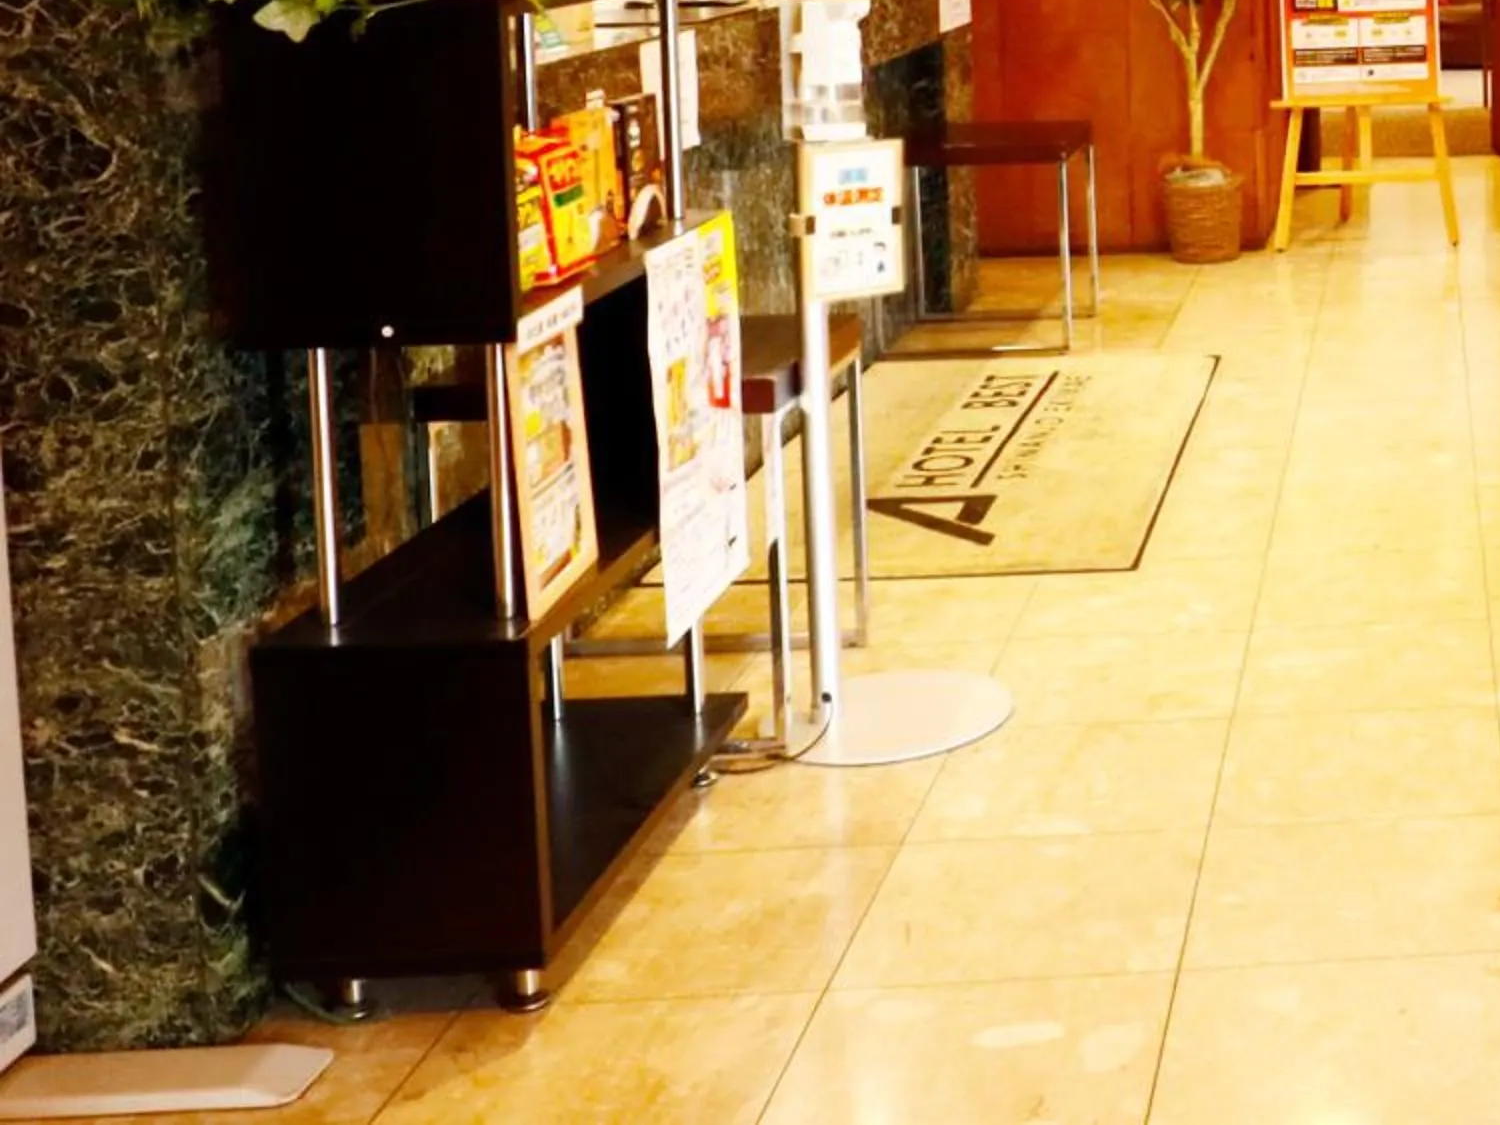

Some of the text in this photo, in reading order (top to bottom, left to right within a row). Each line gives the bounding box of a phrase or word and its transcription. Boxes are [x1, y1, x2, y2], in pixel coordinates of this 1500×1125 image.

[895, 374, 1040, 488] HOTEL BEST
[866, 494, 998, 546] A
